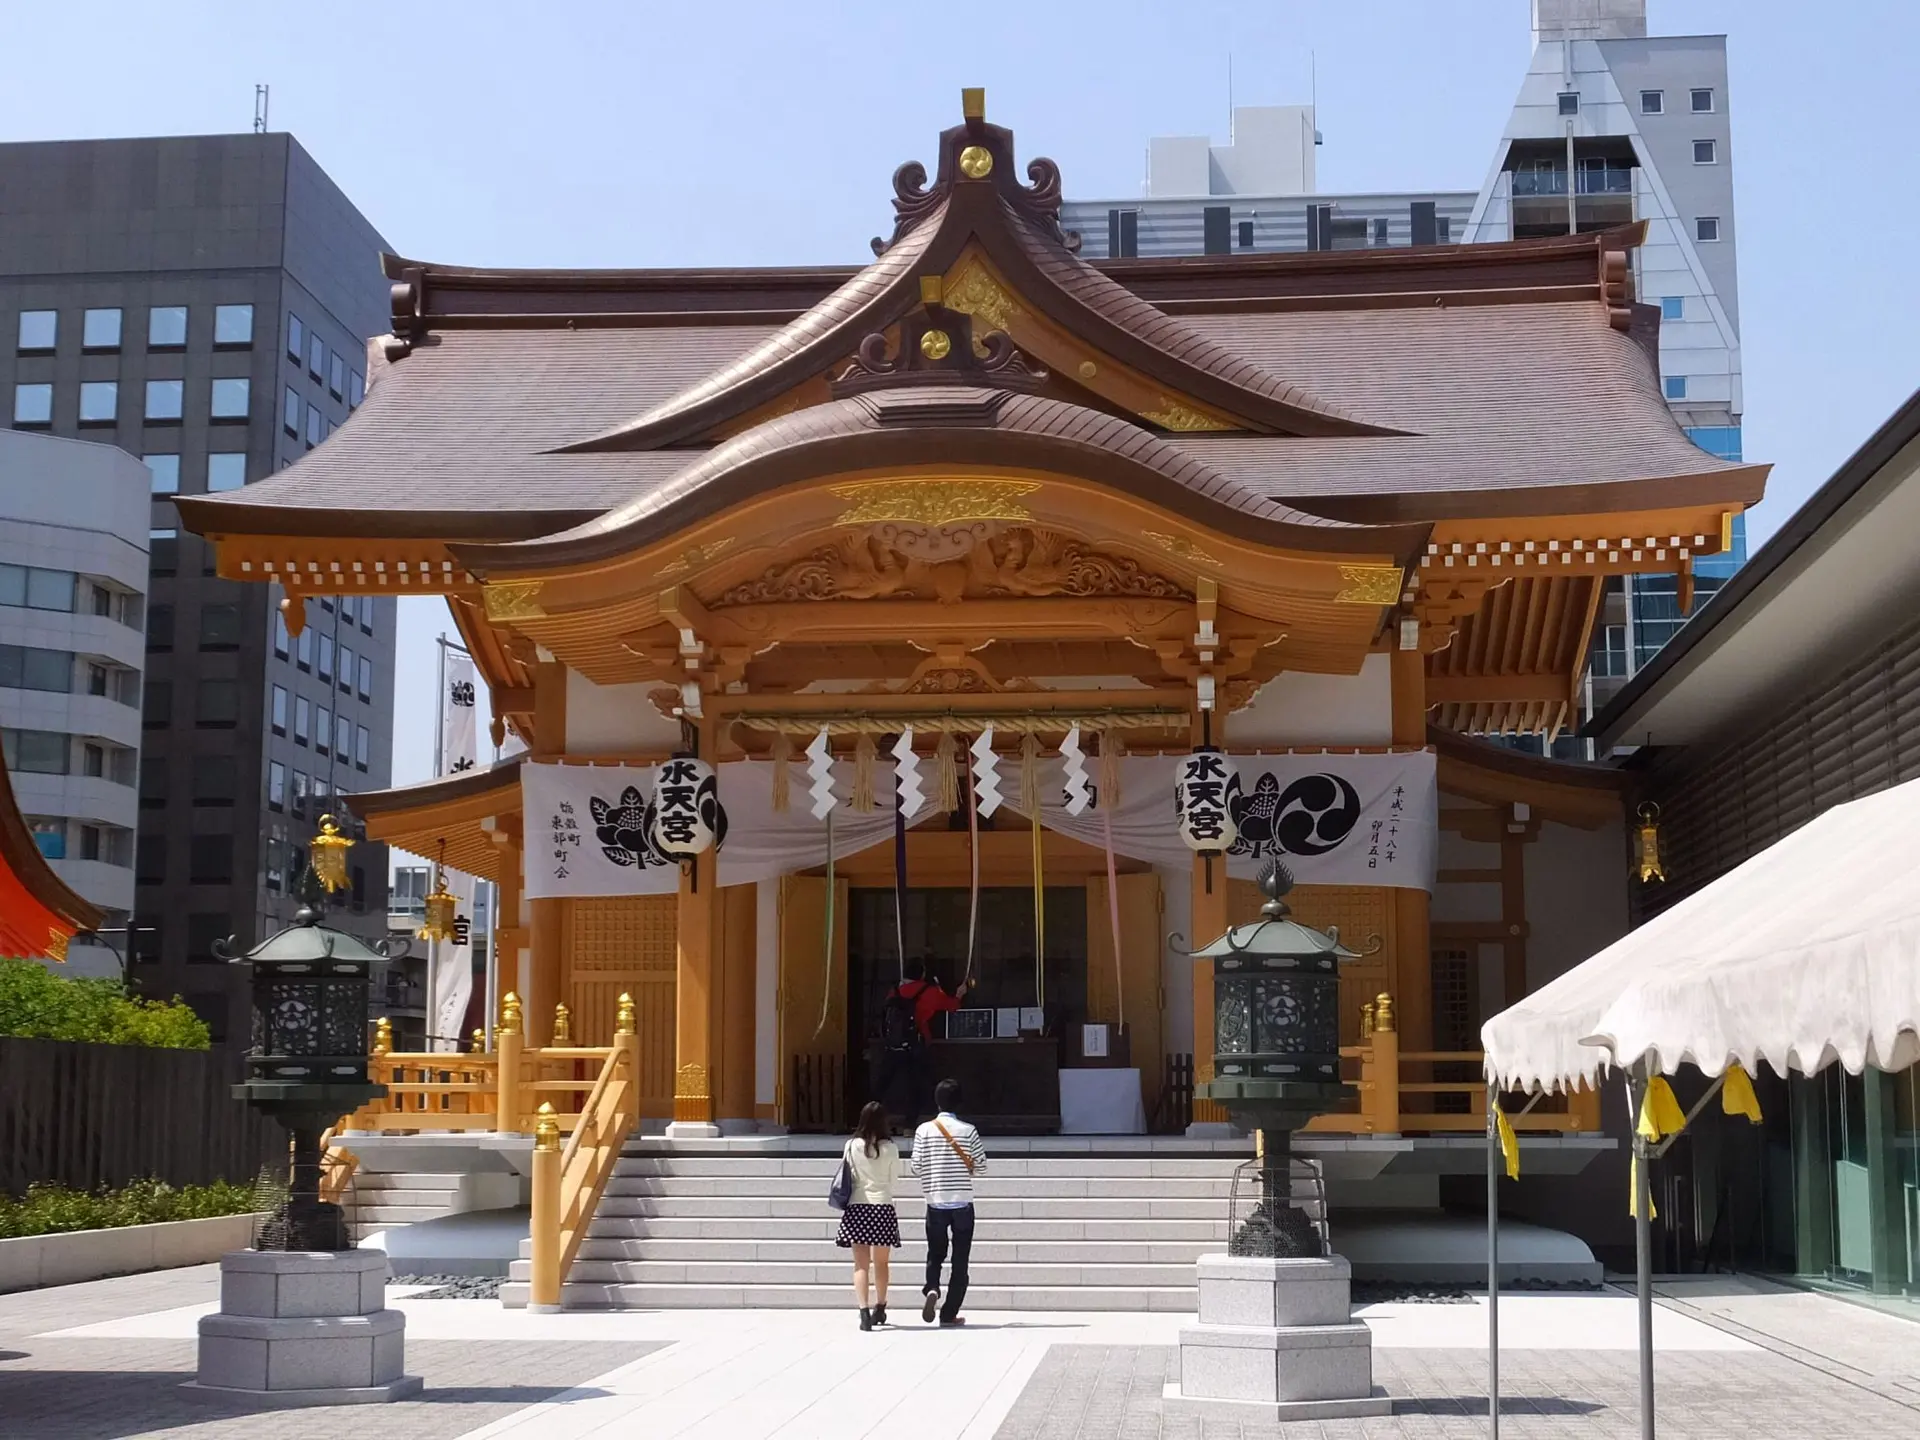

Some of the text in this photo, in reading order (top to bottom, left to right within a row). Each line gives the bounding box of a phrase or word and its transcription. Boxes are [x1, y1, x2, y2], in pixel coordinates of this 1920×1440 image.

[659, 760, 701, 844] 水天宮
[1184, 756, 1227, 840] 水天宮
[1385, 785, 1405, 863] 平成二十八年
[551, 814, 570, 880] 東部町会
[1368, 819, 1383, 869] 卯月五日
